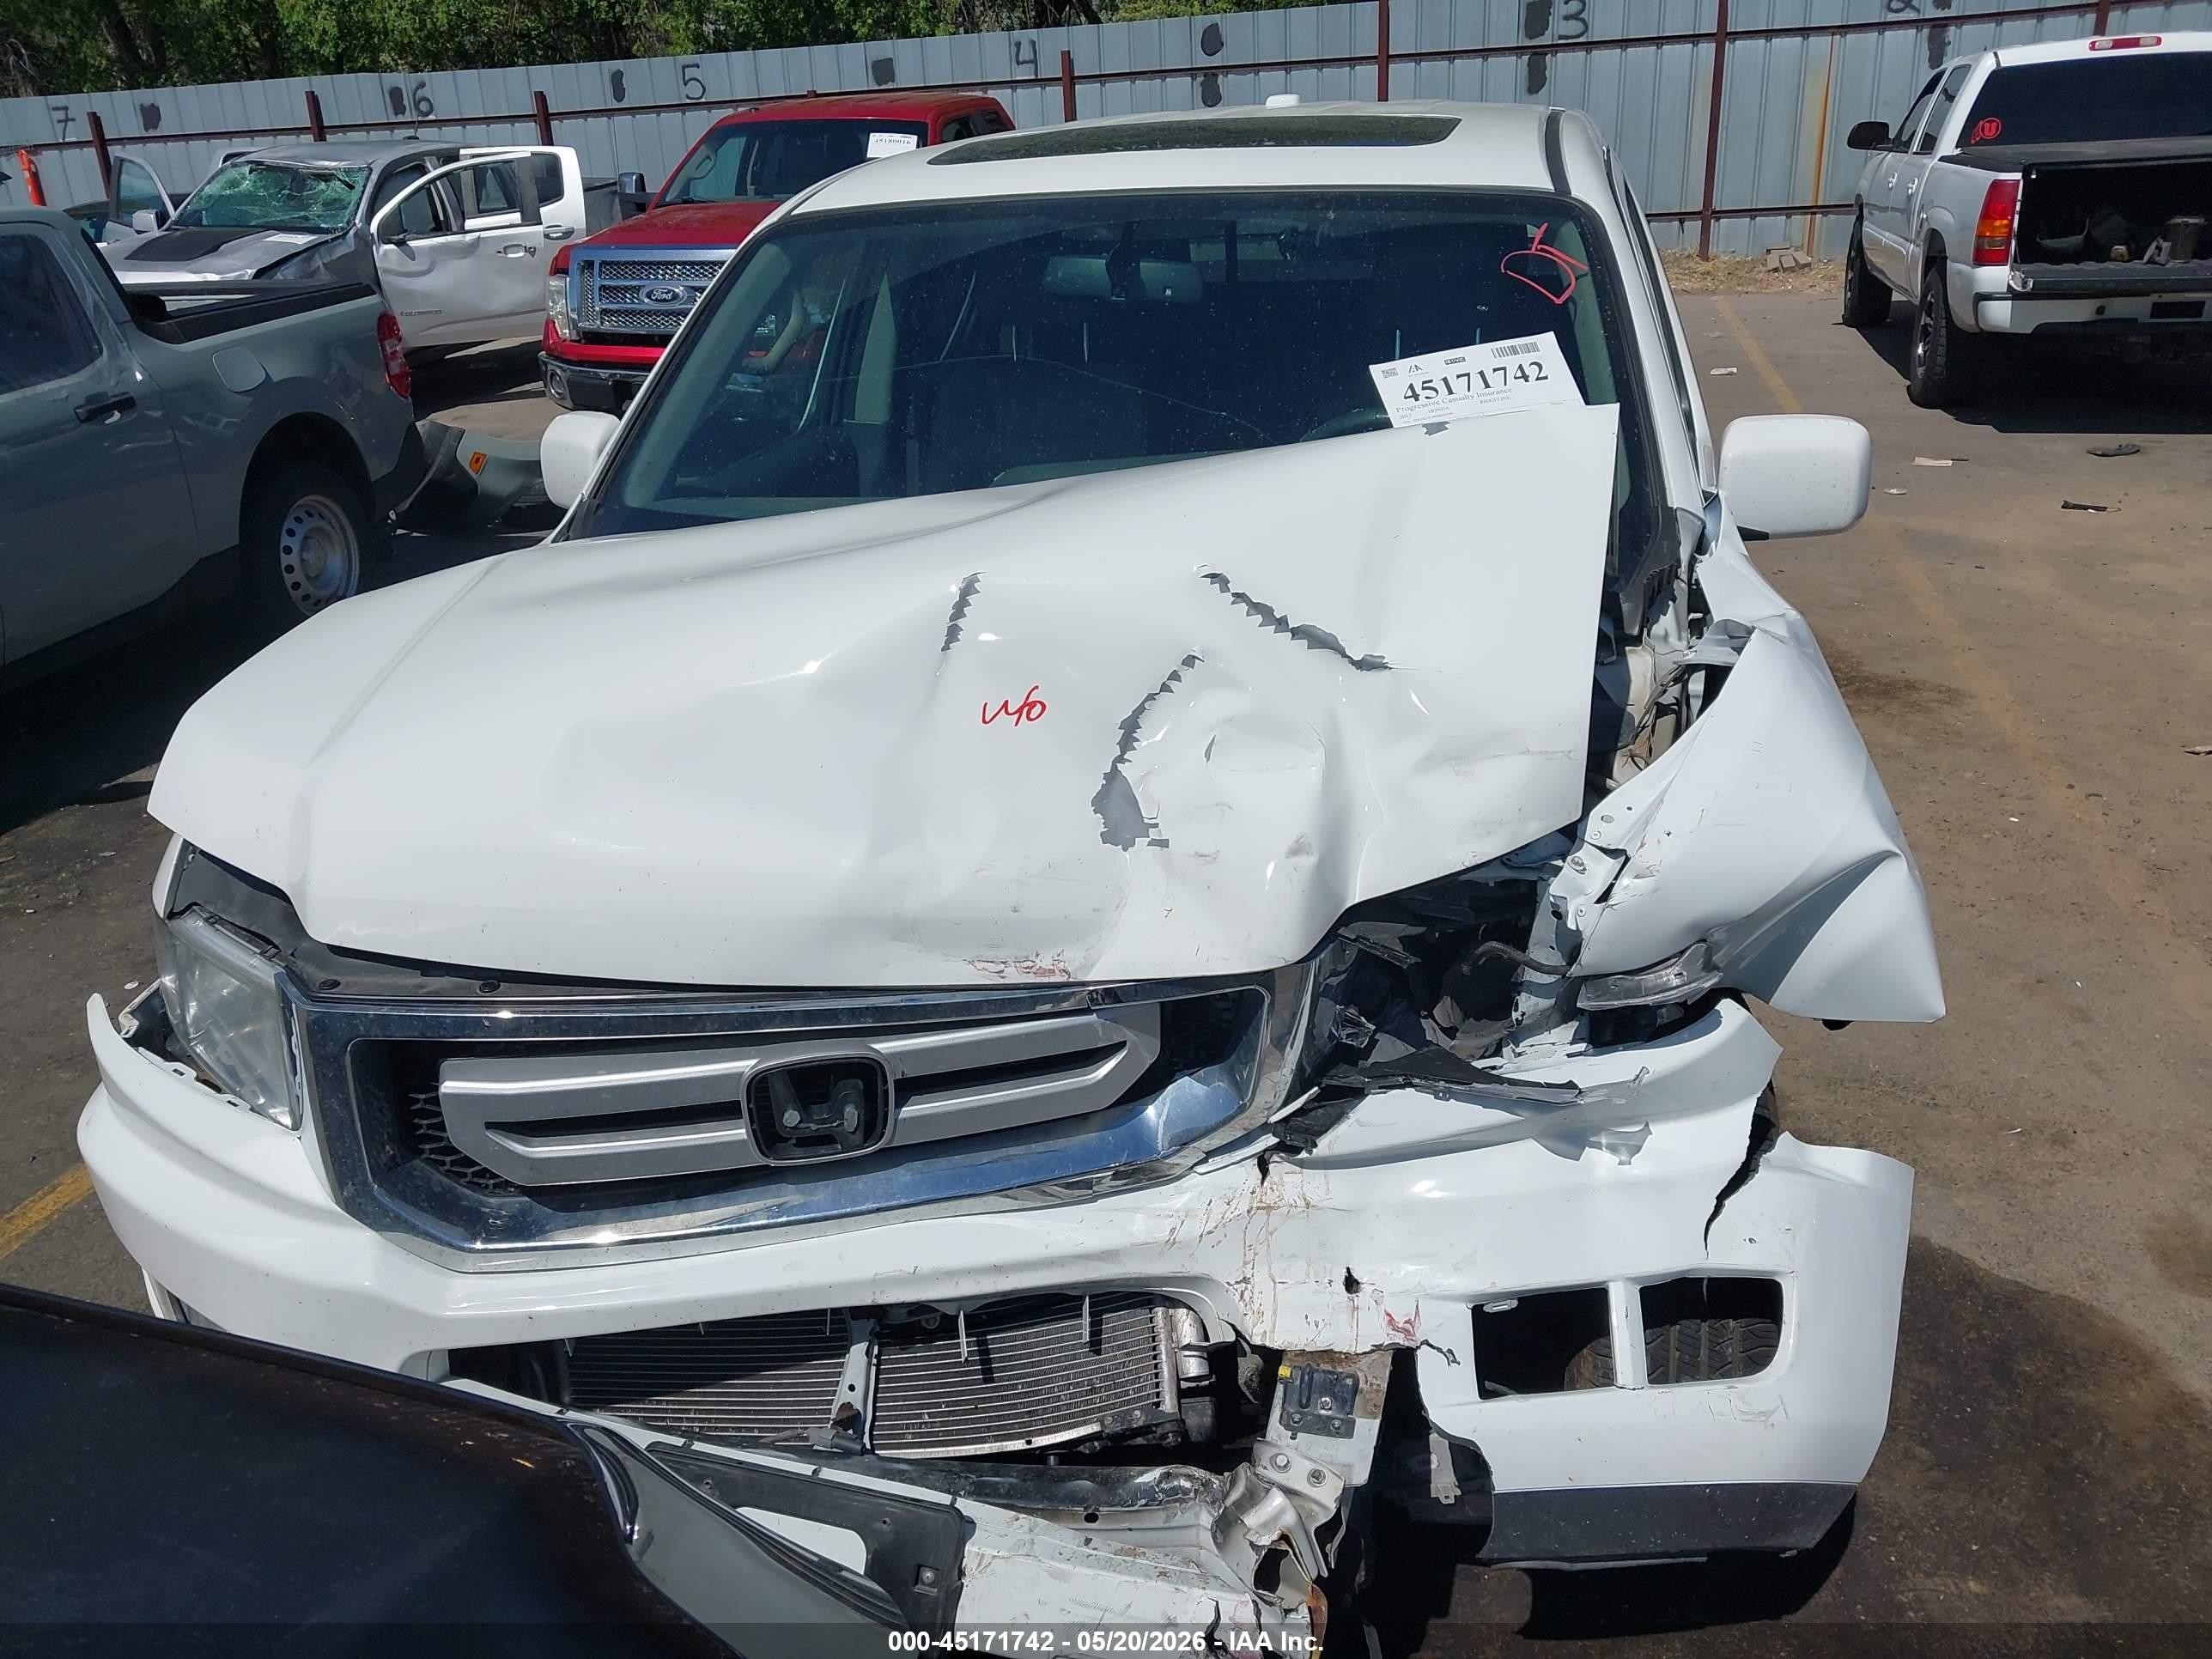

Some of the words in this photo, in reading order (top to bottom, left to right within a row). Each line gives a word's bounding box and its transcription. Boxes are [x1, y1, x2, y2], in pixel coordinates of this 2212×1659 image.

[1557, 0, 1589, 40] 3
[1014, 39, 1038, 78] 4
[412, 81, 434, 118] 6
[681, 63, 707, 100] 5
[52, 105, 76, 142] 7
[651, 289, 673, 300] Ford
[1403, 361, 1549, 402] 45171742
[1395, 401, 1440, 413] Progressive
[1442, 392, 1474, 404] Casualty
[1476, 388, 1512, 398] Insurance
